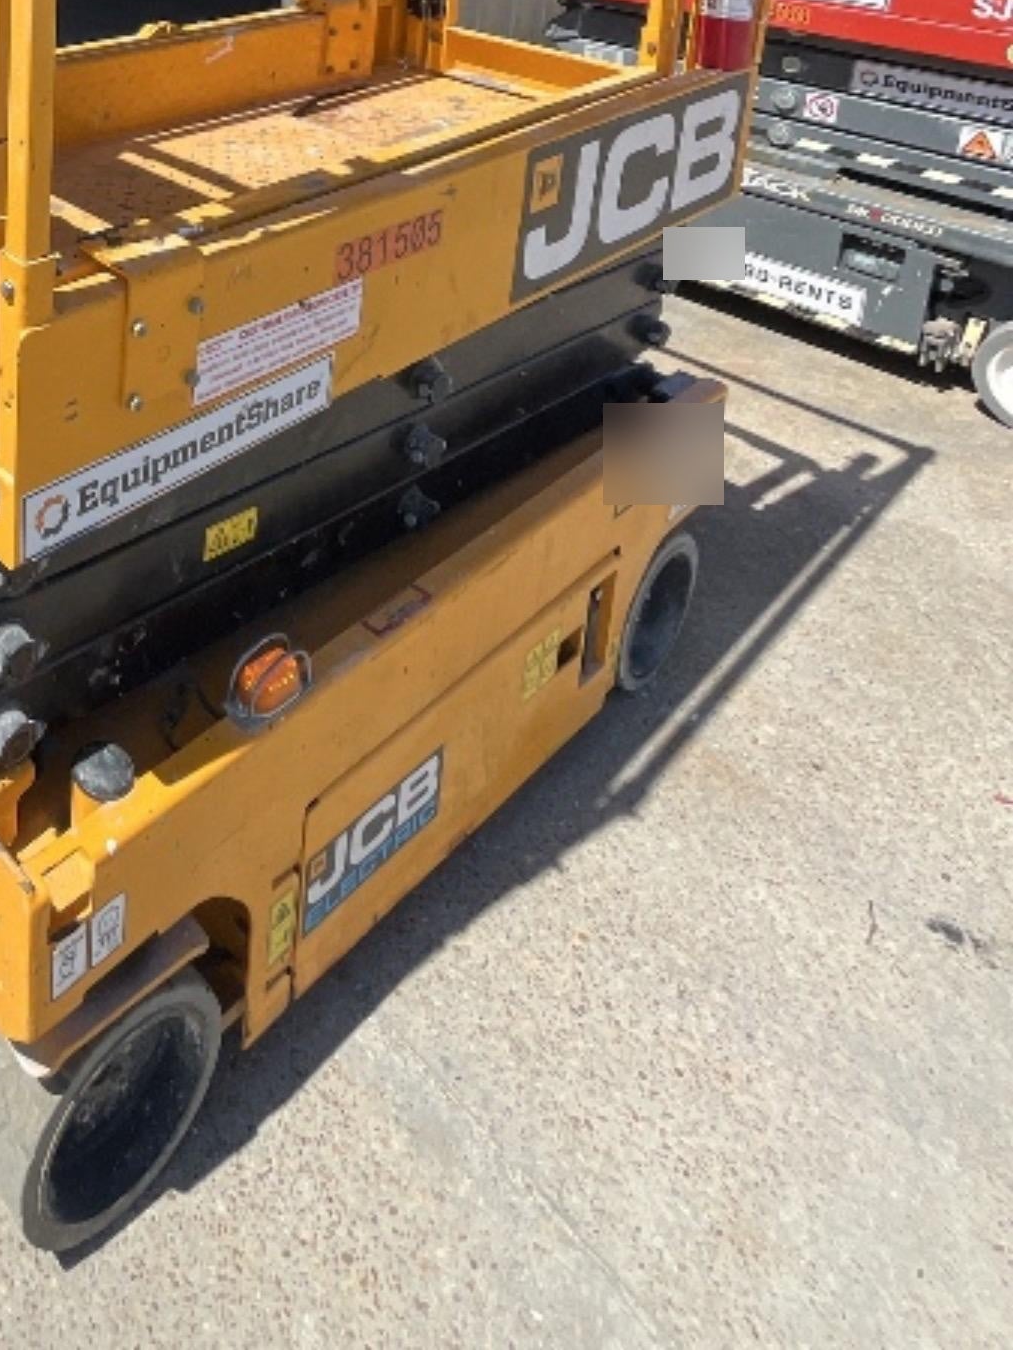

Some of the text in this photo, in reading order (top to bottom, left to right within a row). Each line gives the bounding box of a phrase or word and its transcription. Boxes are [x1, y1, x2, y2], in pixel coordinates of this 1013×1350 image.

[336, 209, 442, 280] 381505
[523, 89, 741, 279] JCB
[76, 378, 322, 517] EquipmentShare
[307, 754, 439, 904] JCB
